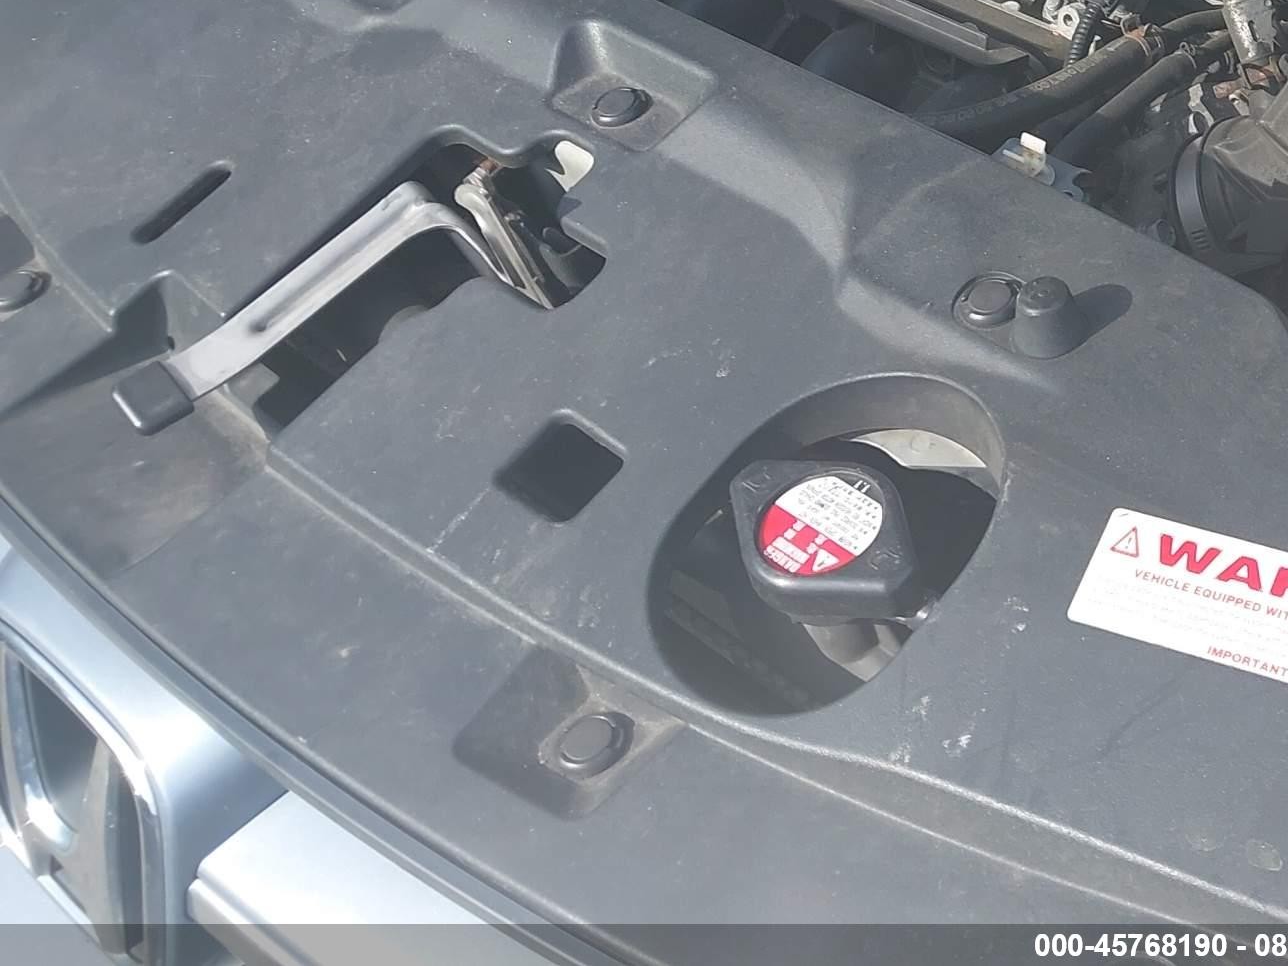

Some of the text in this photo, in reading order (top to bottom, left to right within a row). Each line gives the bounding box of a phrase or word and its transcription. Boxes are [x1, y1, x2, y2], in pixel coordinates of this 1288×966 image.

[1134, 569, 1190, 593] VEHICLE
[1193, 585, 1262, 612] EQUIPPED
[1207, 646, 1288, 677] IMPORTANT
